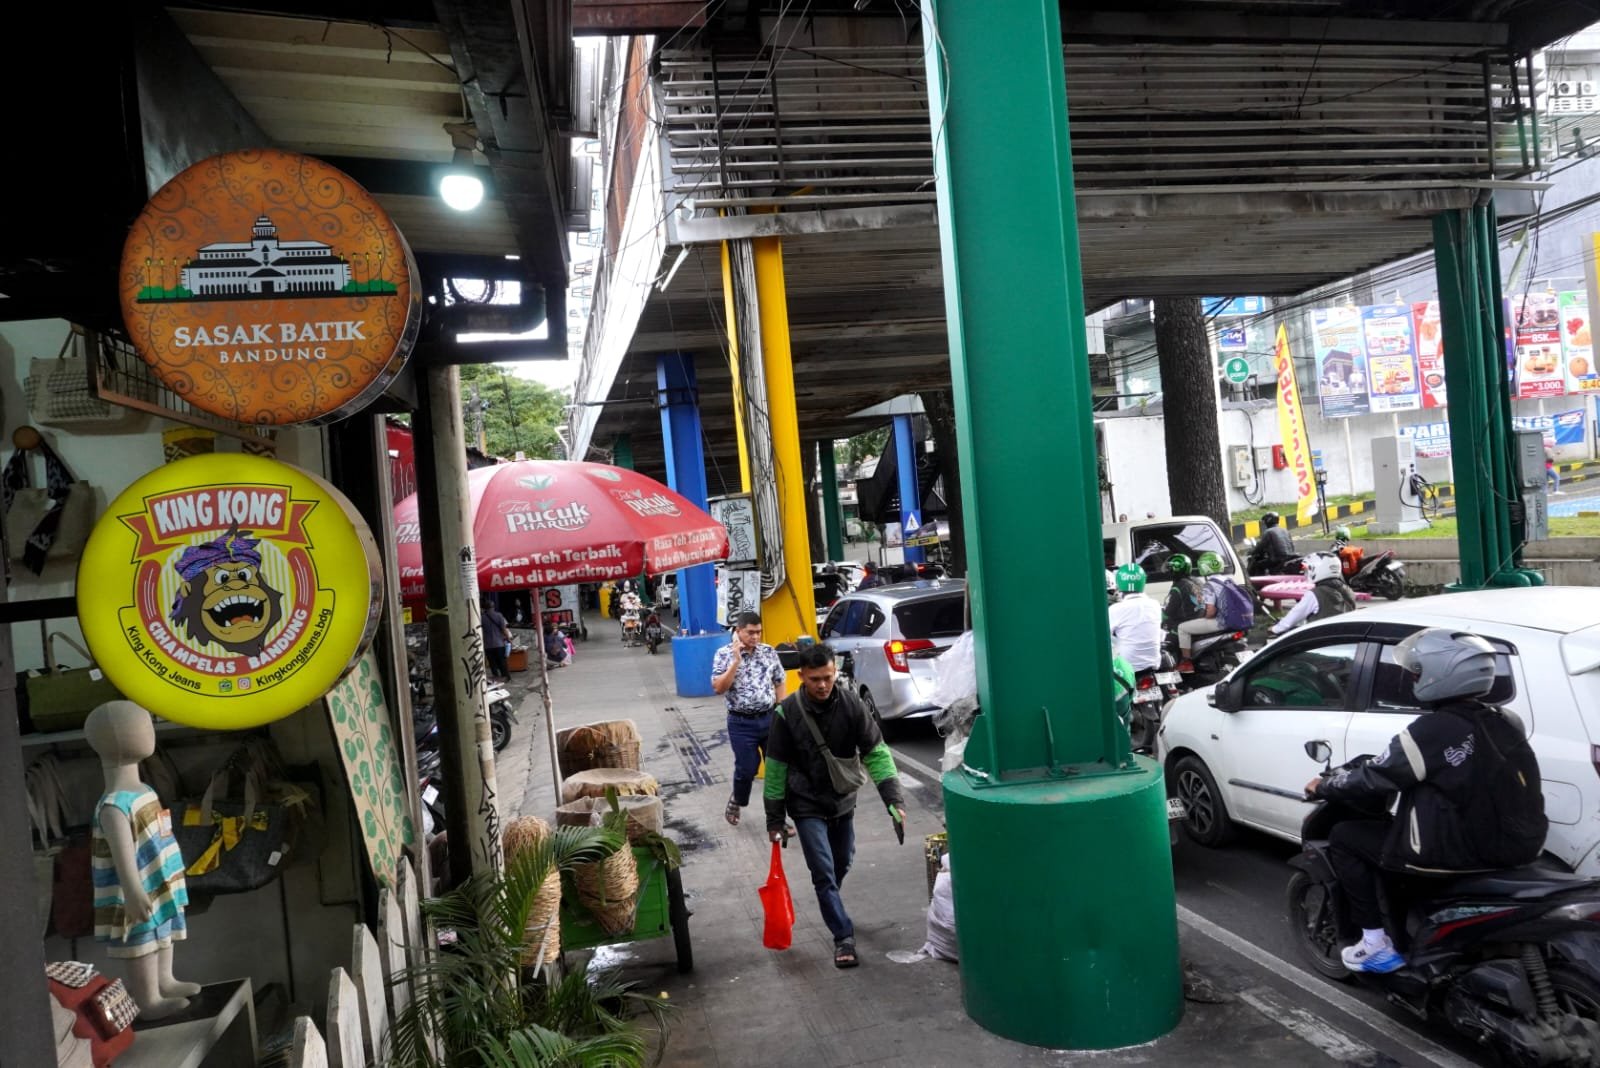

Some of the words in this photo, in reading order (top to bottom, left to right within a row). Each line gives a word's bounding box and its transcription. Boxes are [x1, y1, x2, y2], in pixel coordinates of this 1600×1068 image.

[174, 324, 273, 347] SASAK
[279, 321, 366, 343] BATIK
[220, 347, 327, 363] BANDUNG
[154, 493, 213, 534] KING
[217, 490, 283, 526] KONG
[523, 518, 586, 531] HARUM
[491, 557, 530, 568] Rasa
[531, 551, 561, 564] Teh
[562, 544, 622, 562] Terbaik
[491, 572, 524, 587] Ada
[527, 570, 543, 583] di
[545, 561, 628, 582] Pucuknya!
[150, 621, 236, 673] CIHAMPELAS
[247, 609, 308, 669] BANDUNG
[256, 608, 331, 687] Kingkongjeans.bdg
[127, 625, 145, 651] King
[143, 650, 168, 676] Kong
[169, 672, 202, 690] Jeans
